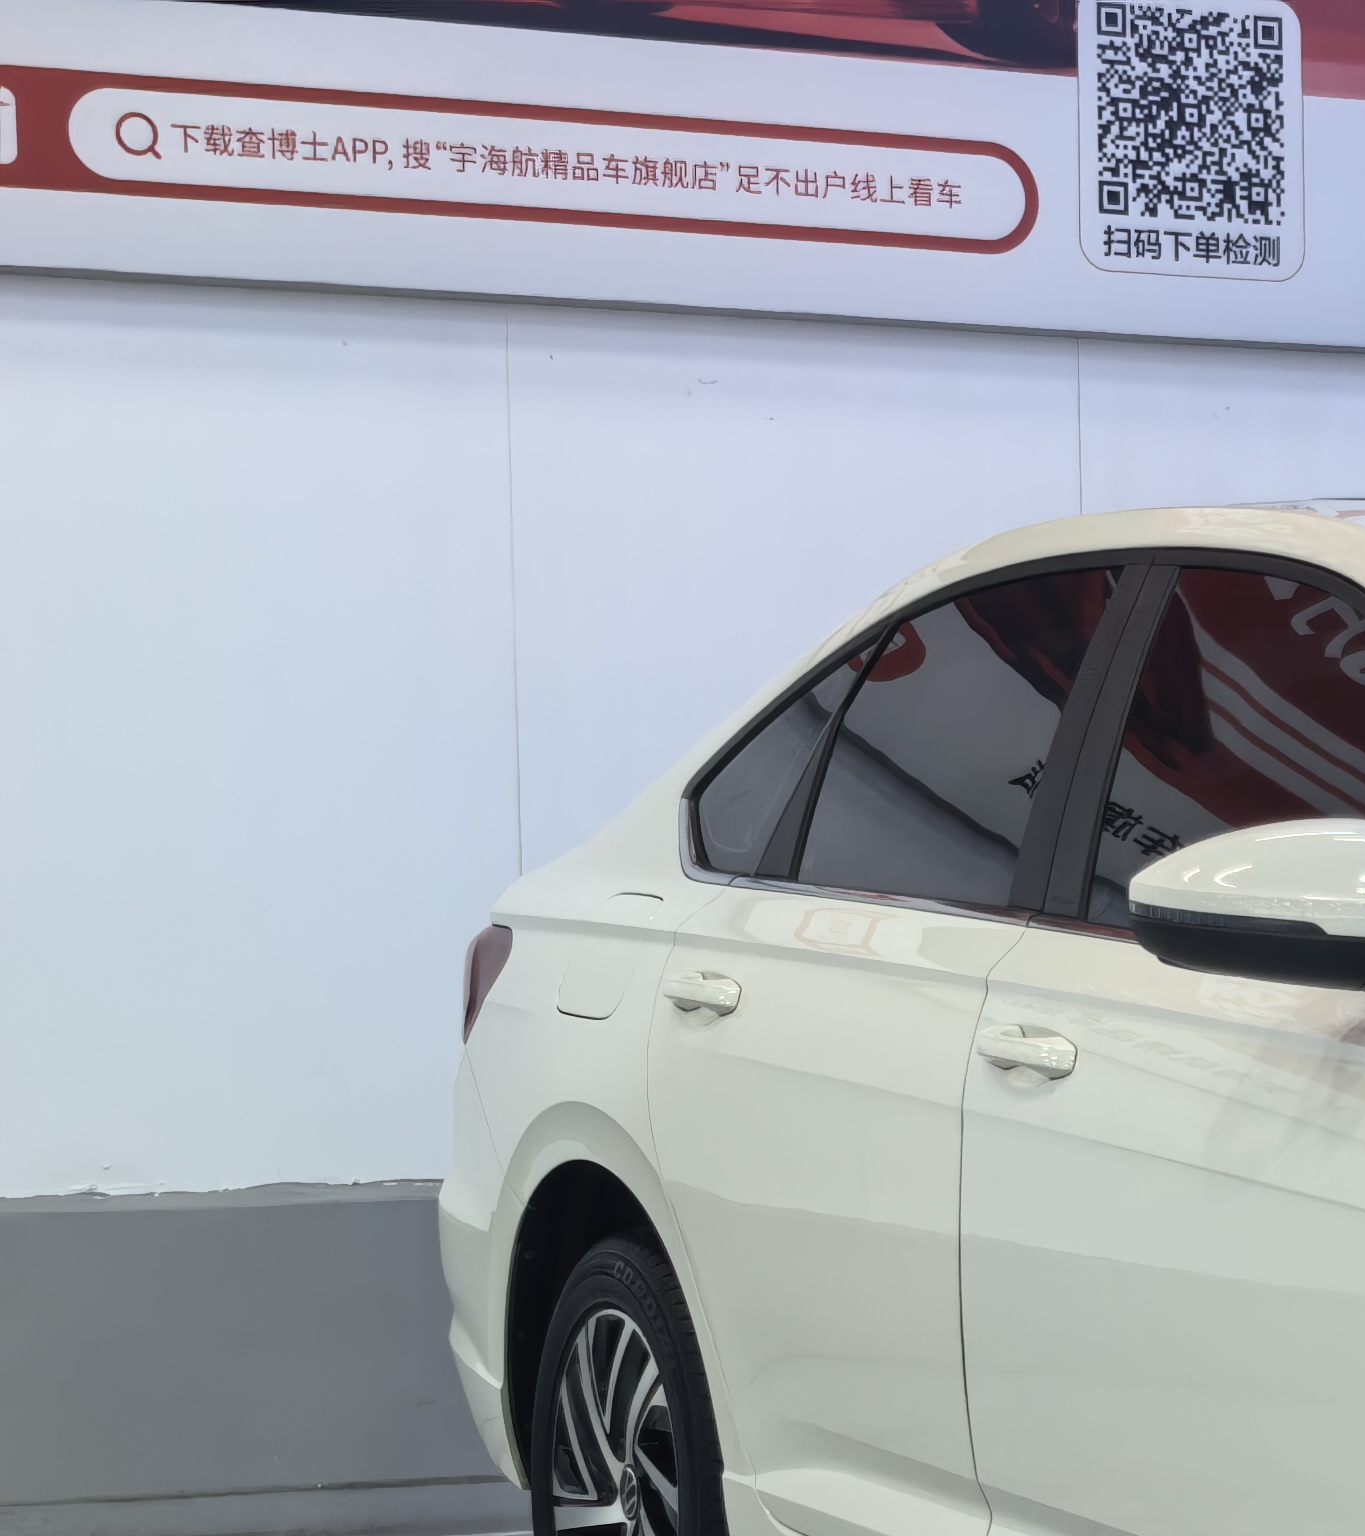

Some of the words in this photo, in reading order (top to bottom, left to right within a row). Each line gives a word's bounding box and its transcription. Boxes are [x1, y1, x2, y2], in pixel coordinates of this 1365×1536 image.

[1102, 225, 1281, 267] 扫码下单检测
